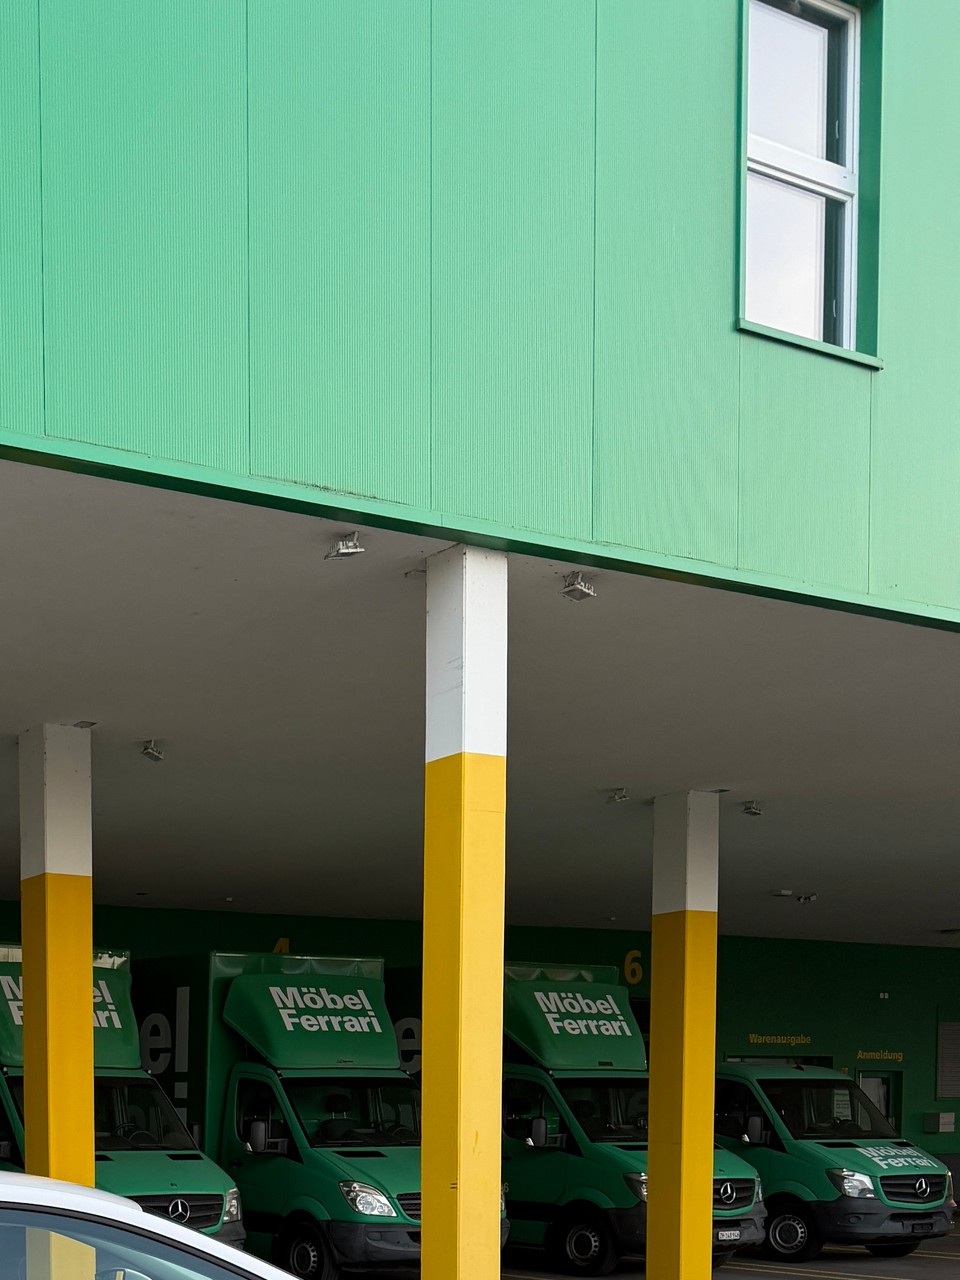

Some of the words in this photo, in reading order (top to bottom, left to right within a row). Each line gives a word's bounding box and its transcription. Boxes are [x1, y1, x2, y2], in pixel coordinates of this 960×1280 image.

[624, 950, 643, 985] 6
[268, 986, 373, 1011] Möbel
[533, 991, 621, 1015] Möbel
[278, 1008, 383, 1033] Ferrari
[544, 1013, 633, 1037] Ferrari
[749, 1033, 812, 1046] Warenausgabe
[856, 1049, 904, 1062] Anmeldung
[856, 1146, 924, 1158] Möbel
[870, 1156, 939, 1170] Ferrari
